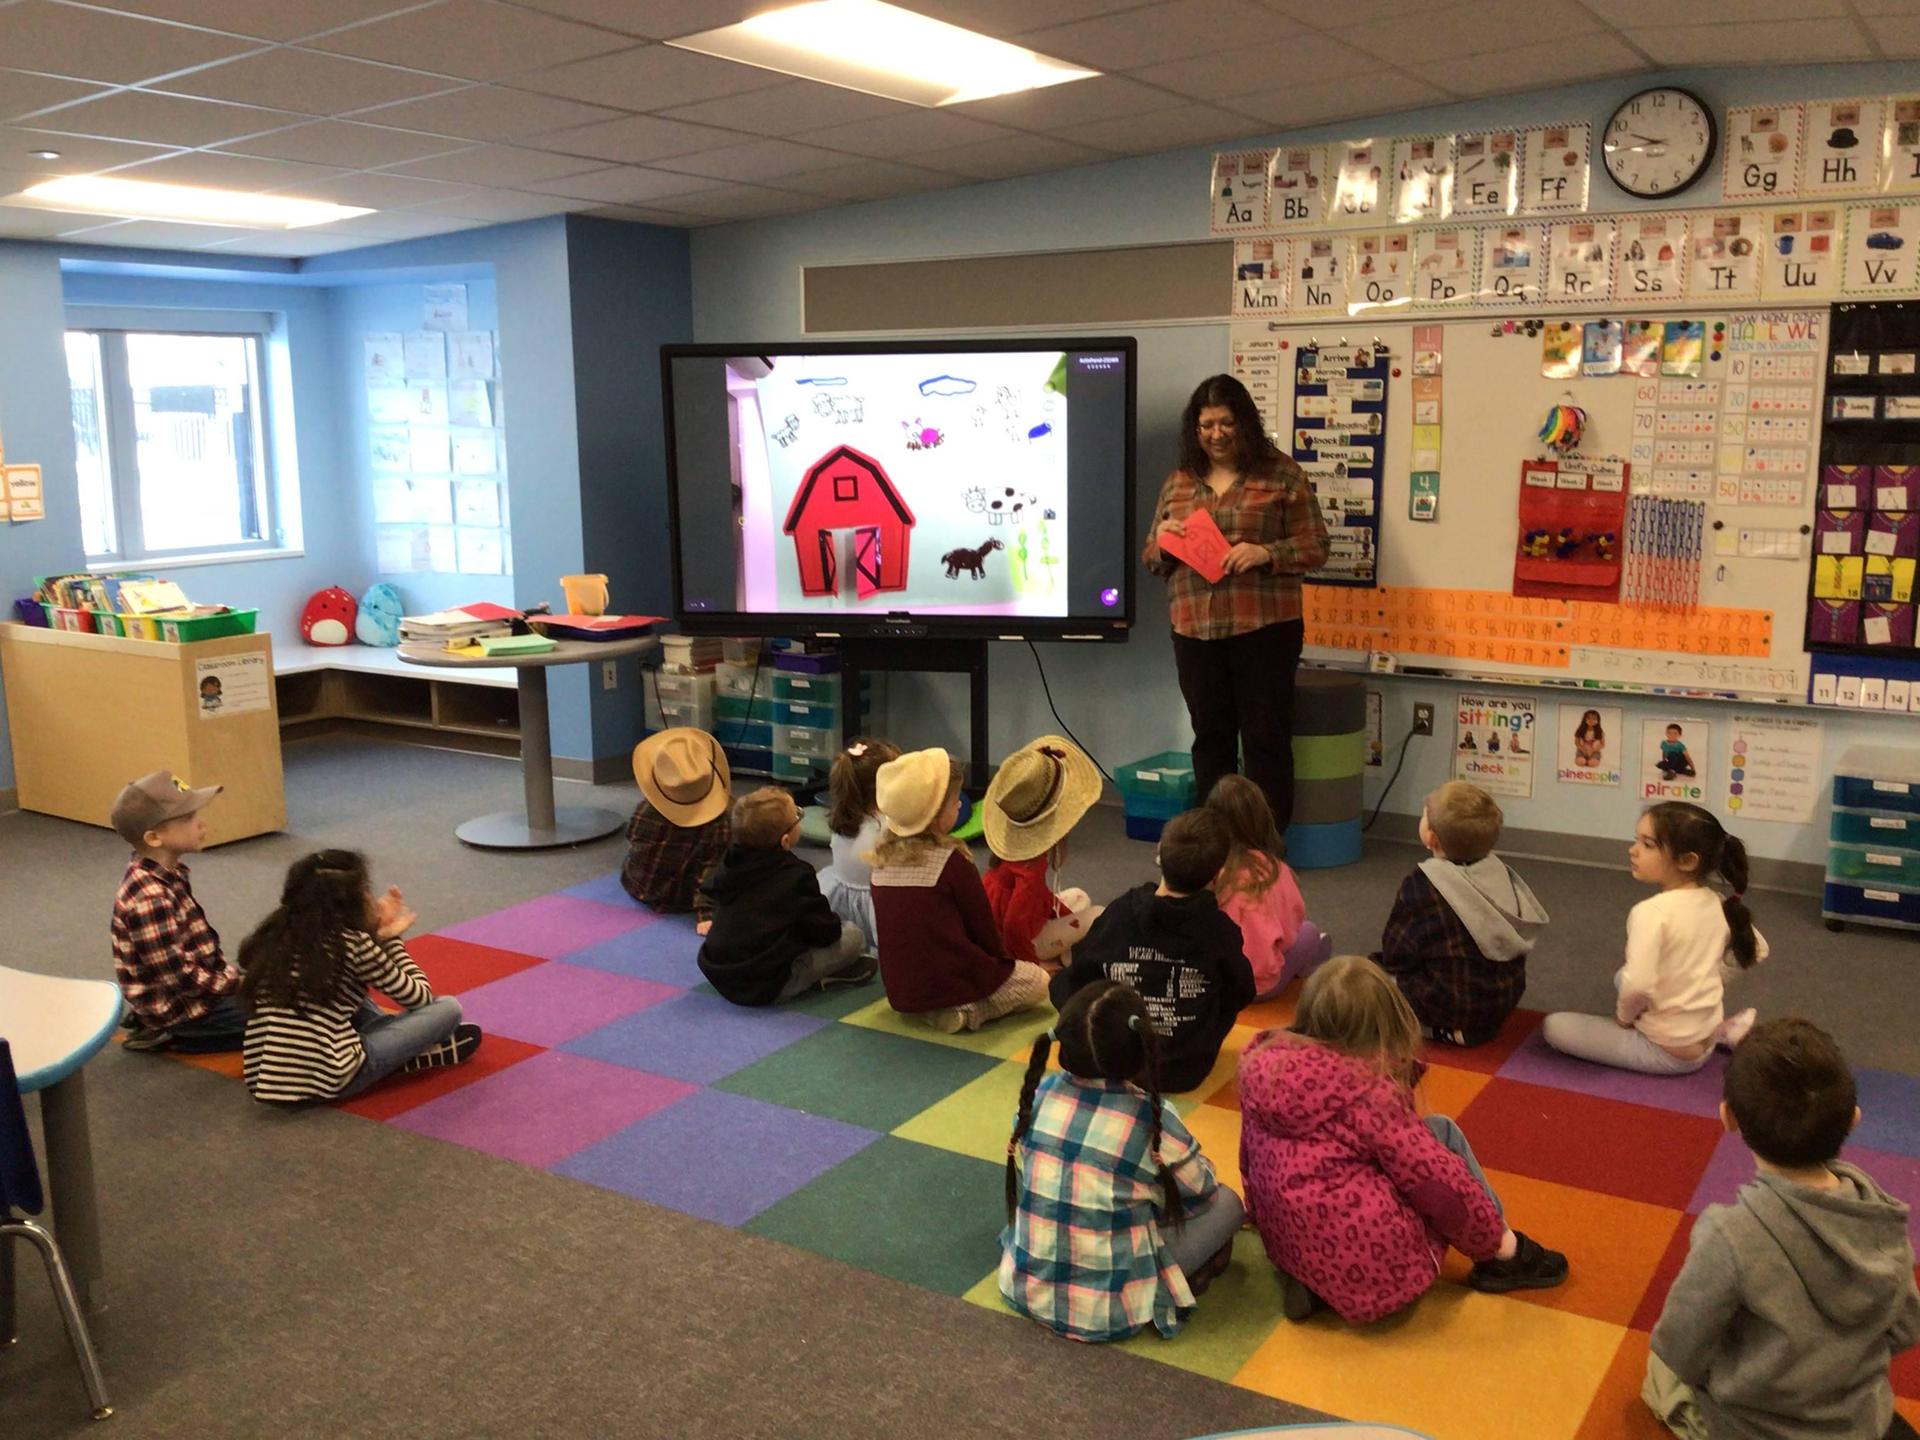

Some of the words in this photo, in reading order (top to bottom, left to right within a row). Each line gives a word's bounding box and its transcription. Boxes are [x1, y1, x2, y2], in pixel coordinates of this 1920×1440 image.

[1631, 102, 1640, 115] 11
[1652, 94, 1665, 107] 12
[1614, 120, 1628, 132] 10
[1690, 111, 1699, 126] 2
[1696, 131, 1704, 145] 3
[1615, 158, 1625, 171] 8
[1687, 153, 1695, 166] 4
[1673, 170, 1681, 184] 5
[1743, 163, 1777, 191] Gg
[1822, 158, 1857, 183] Hh
[1630, 173, 1639, 186] 7
[1650, 181, 1659, 192] 6
[1471, 183, 1499, 205] Ee
[1540, 177, 1567, 201] Ff
[1226, 202, 1253, 224] Aa
[1284, 197, 1309, 219] Bb
[1710, 266, 1737, 290] Tt
[1783, 264, 1816, 287] Uu
[1864, 260, 1897, 284] Vv
[1494, 275, 1528, 301] Qq
[1564, 272, 1592, 295] Rr
[1634, 270, 1662, 292] Ss
[1243, 288, 1278, 308] Mm
[1306, 285, 1332, 305] Nn
[1366, 281, 1394, 302] Oo
[1430, 278, 1456, 302] Pp
[1322, 354, 1350, 363] Arrive
[1637, 385, 1657, 401] 60
[1635, 413, 1653, 429] 70
[1312, 436, 1337, 445] Snack
[1320, 451, 1348, 459] Recess
[1819, 688, 1829, 698] 11
[1843, 690, 1855, 700] 12
[1867, 692, 1879, 702] 13
[1891, 694, 1903, 704] 14
[1461, 696, 1485, 709] How
[1488, 700, 1508, 710] are
[1511, 701, 1531, 712] you
[1459, 708, 1535, 732] sitting?
[1465, 760, 1505, 775] check
[1557, 766, 1620, 784] pineapple
[1645, 780, 1702, 799] pirate
